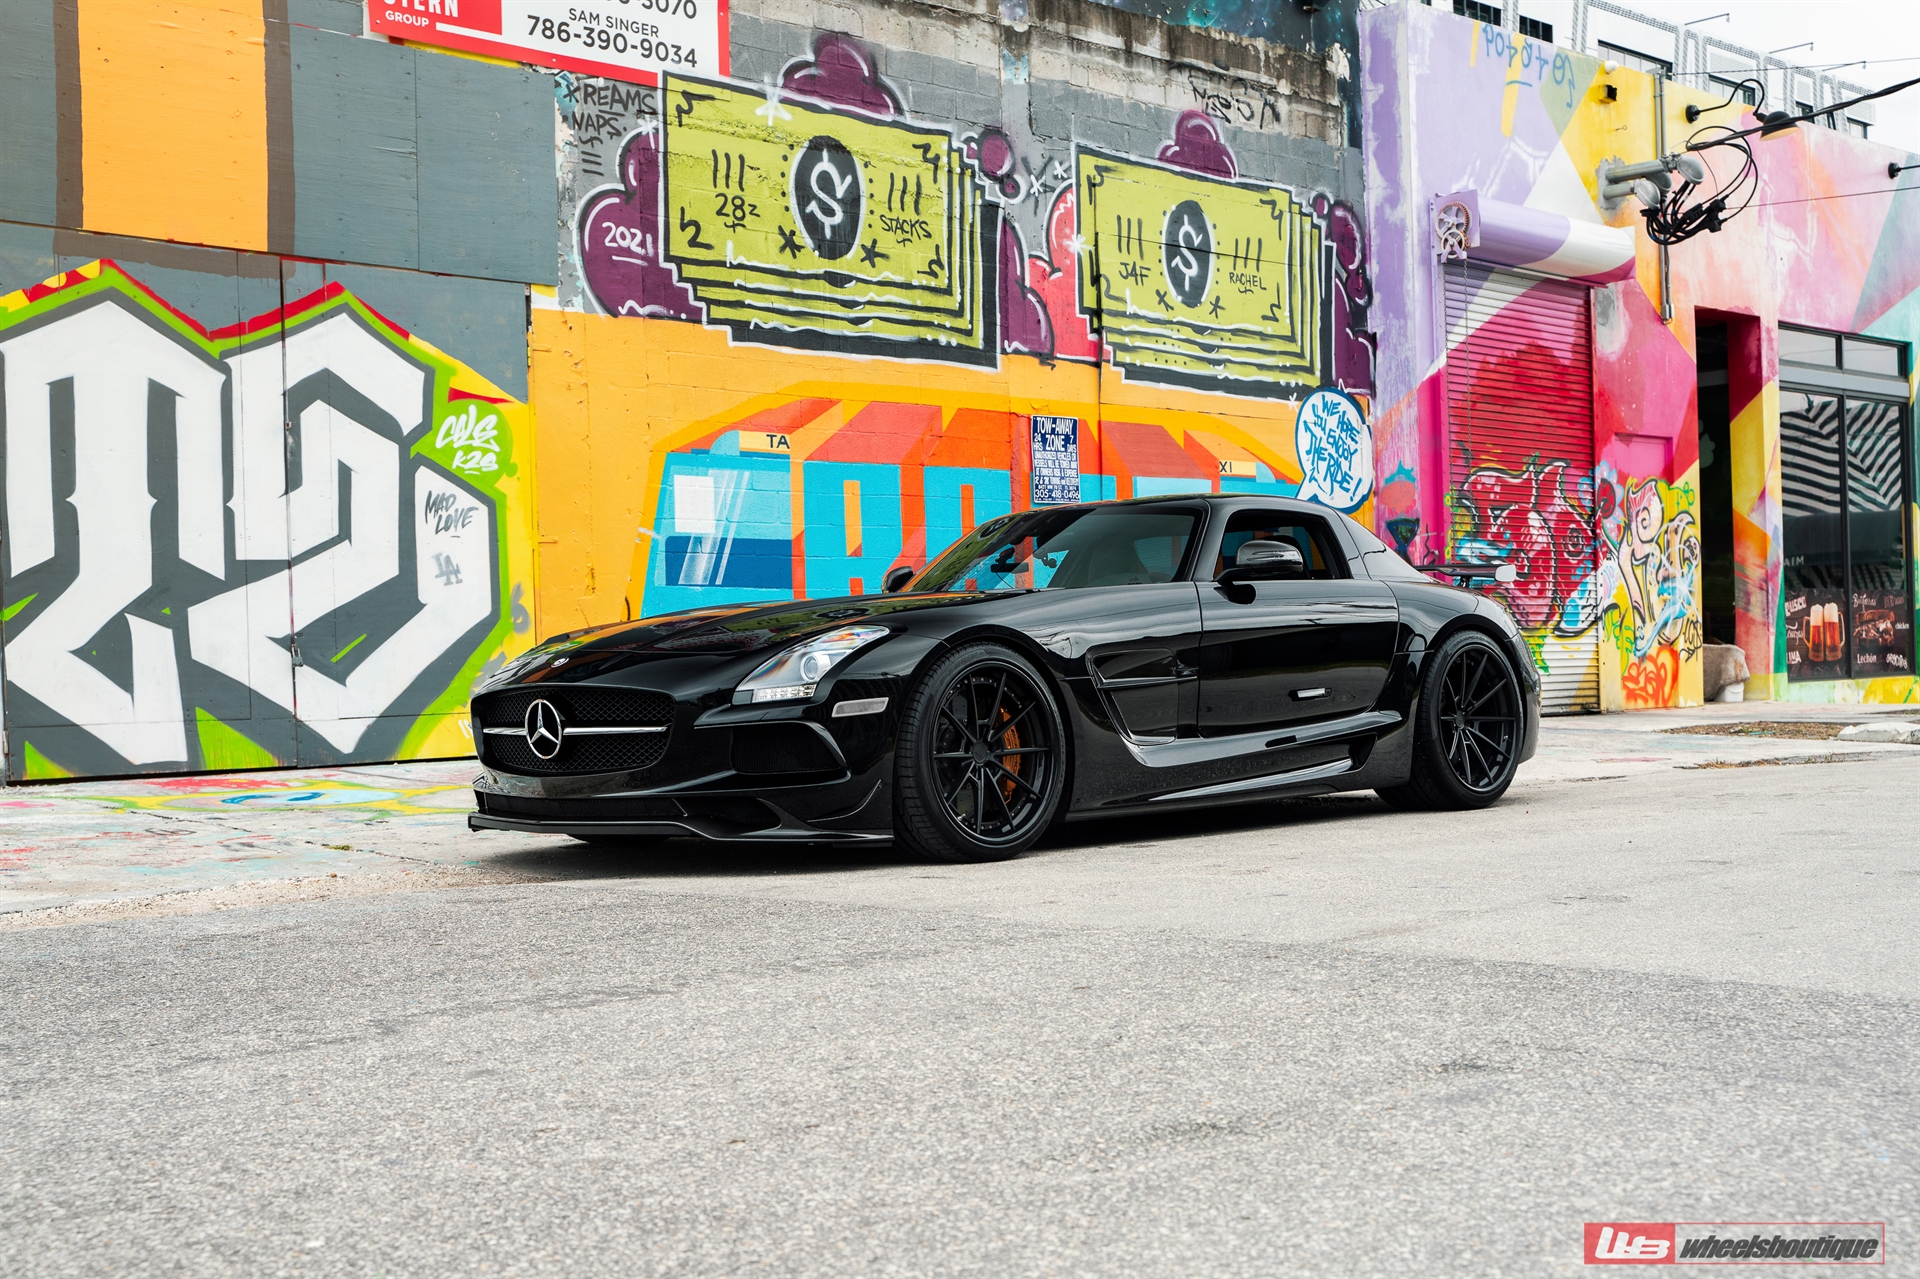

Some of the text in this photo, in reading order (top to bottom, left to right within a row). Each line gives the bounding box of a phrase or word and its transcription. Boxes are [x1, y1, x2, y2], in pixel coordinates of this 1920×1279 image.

[384, 0, 458, 18] ERN
[385, 10, 429, 27] GROUP
[569, 8, 659, 38] SAM SINGER
[527, 14, 698, 68] 786-390-9034
[879, 214, 932, 240] STACKS
[602, 222, 653, 257] 2021
[1229, 271, 1267, 291] RACHEL
[1036, 416, 1074, 435] TOW-AWAY
[1322, 394, 1361, 445] WE HOPE
[766, 434, 790, 449] TA
[1034, 432, 1042, 442] 24
[1045, 434, 1065, 451] ZONE
[1069, 435, 1074, 444] 7
[1303, 420, 1328, 474] THE
[1326, 428, 1358, 472] ENJOY
[1219, 461, 1232, 473] XI
[435, 506, 479, 535] LOVE
